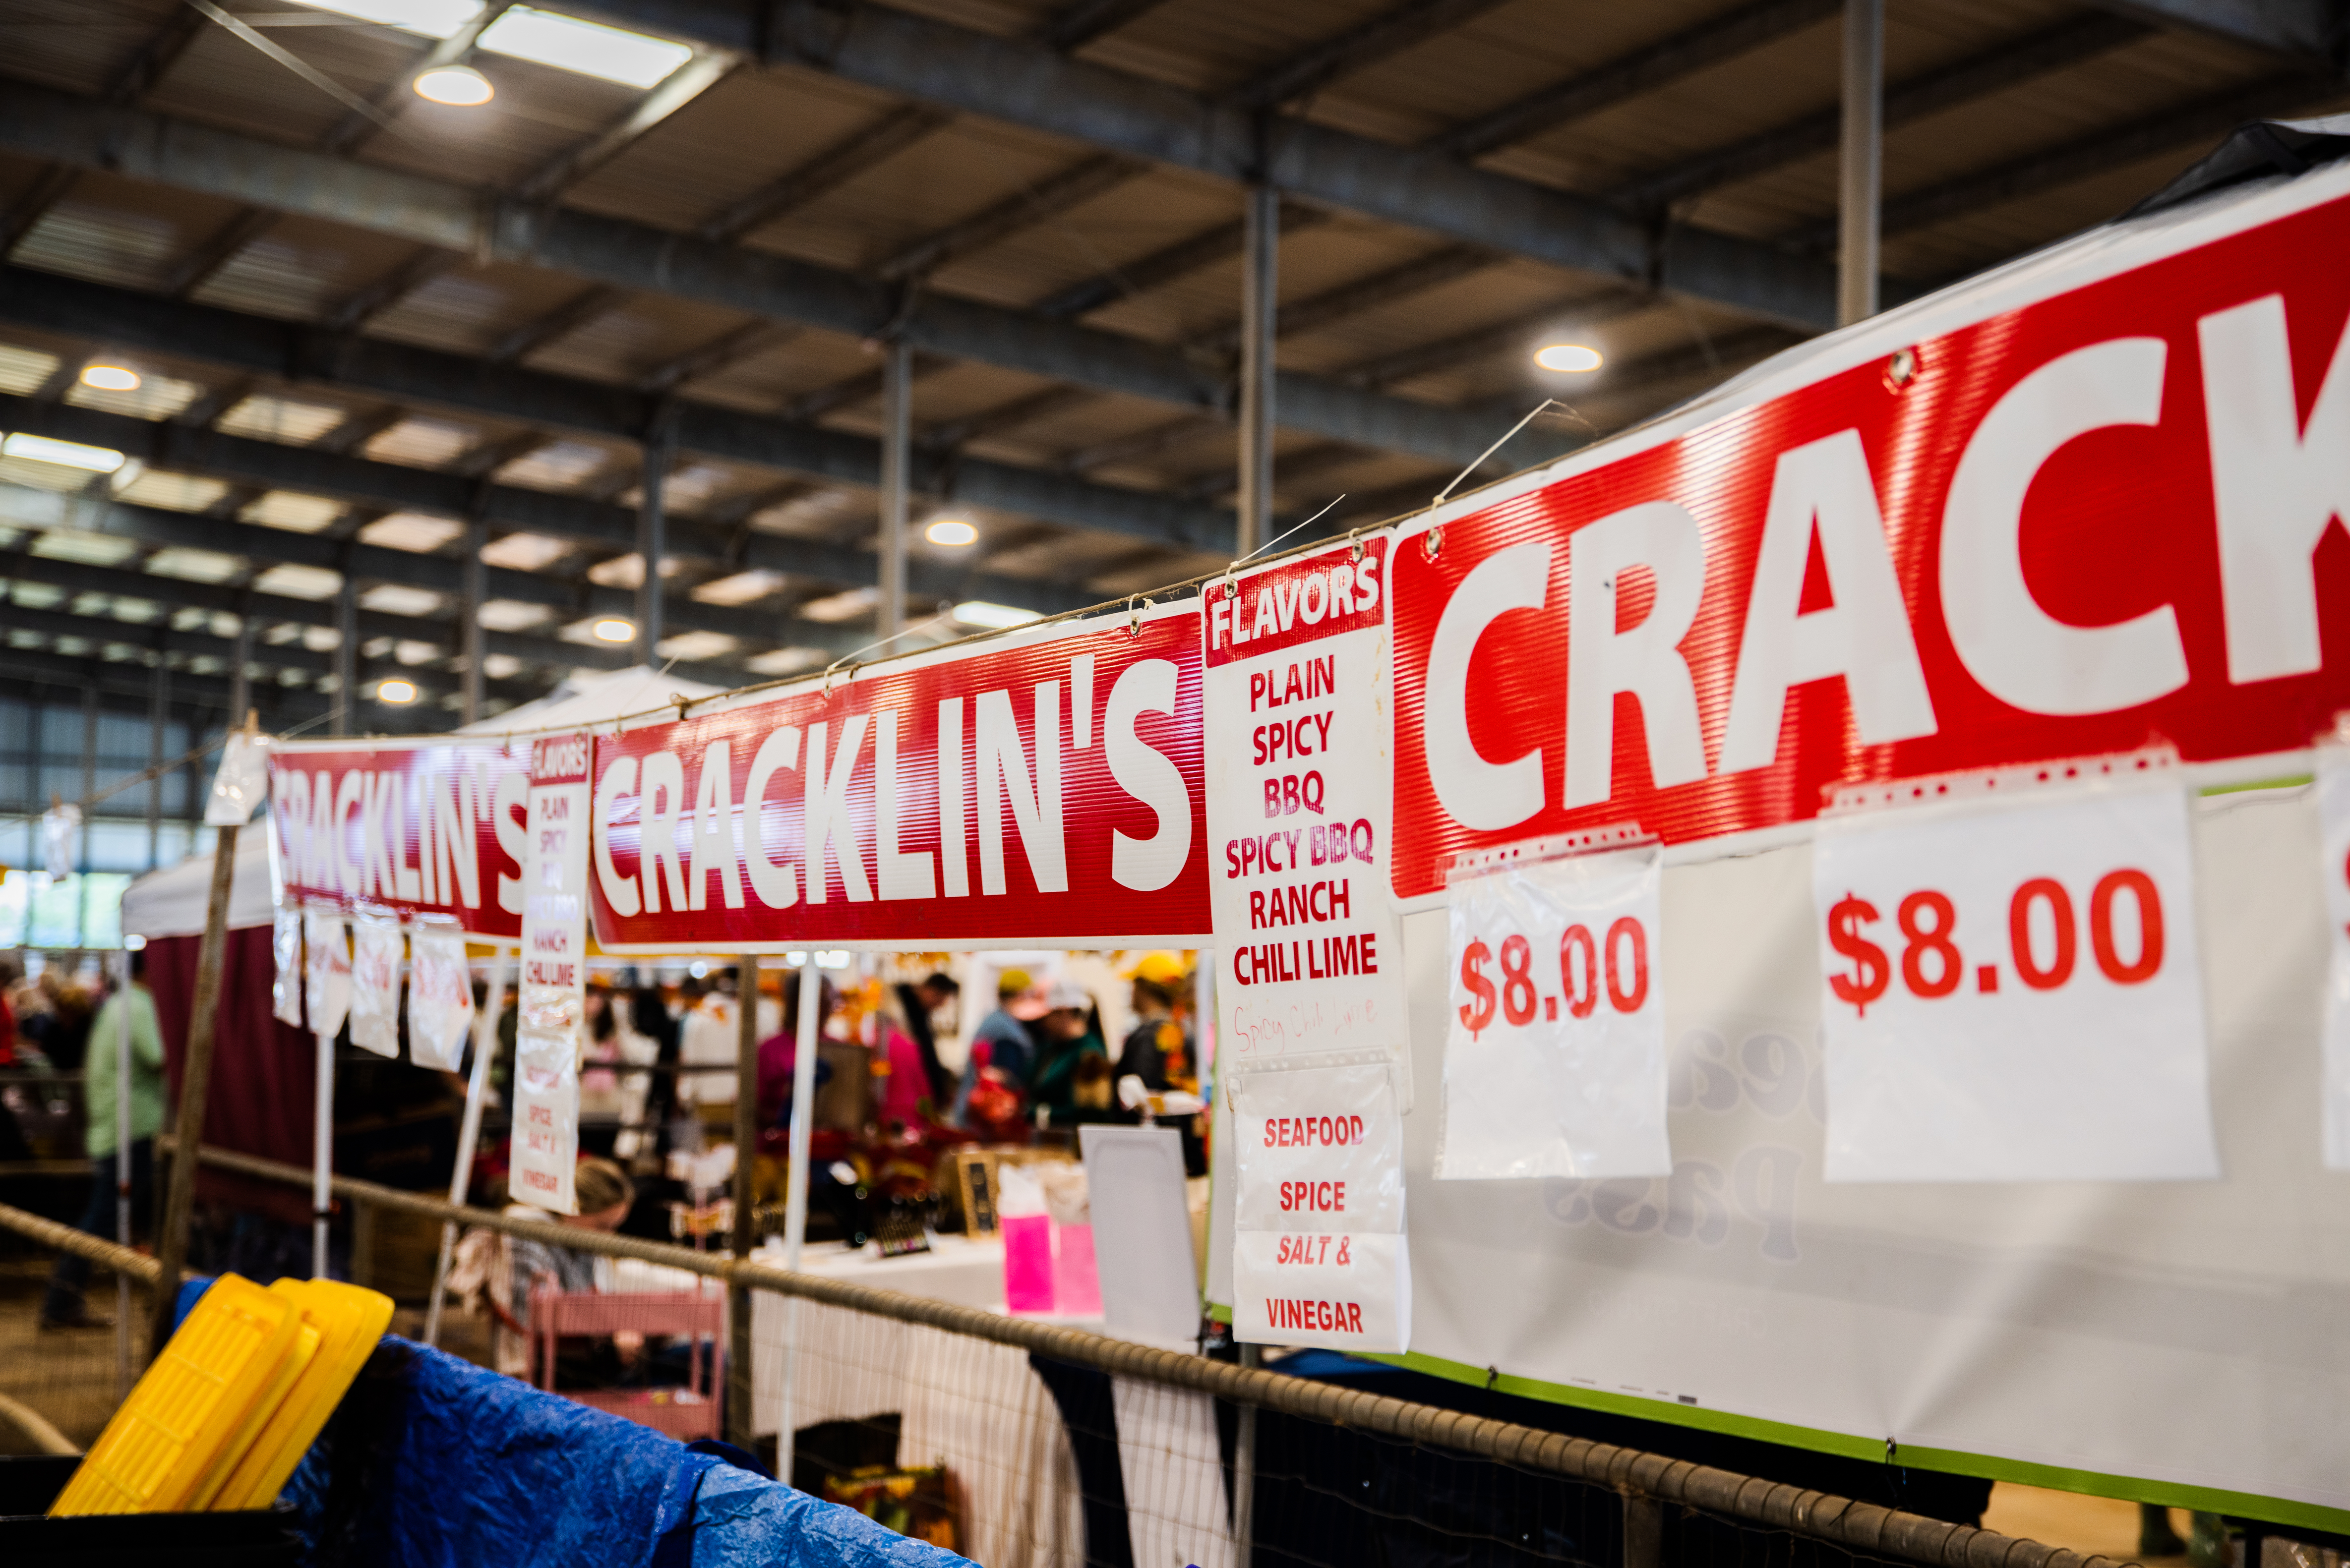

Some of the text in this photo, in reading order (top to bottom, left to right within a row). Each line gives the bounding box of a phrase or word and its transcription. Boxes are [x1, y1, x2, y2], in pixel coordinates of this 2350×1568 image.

[1424, 291, 2350, 832] CRACK
[1211, 556, 1381, 651] FLAVORS
[1250, 654, 1334, 712] PLAIN
[1253, 711, 1333, 766] SPICY
[594, 654, 1192, 918] CRACKLIN'S
[1264, 770, 1325, 818] BBQ
[273, 762, 529, 915] CRACKLIN'S
[1226, 818, 1374, 879] SPICY BBQ
[1250, 878, 1350, 930] RANCH
[1233, 933, 1378, 987] CHILI LIME
[1827, 867, 2166, 1019] $8.00
[1459, 916, 1649, 1043] $8.00
[1235, 1007, 1285, 1057] Spicy
[1264, 1115, 1364, 1148] SEAFOOD
[1280, 1181, 1346, 1212] SPICE
[1277, 1236, 1351, 1267] SALT &
[1265, 1298, 1364, 1334] VINEGAR
